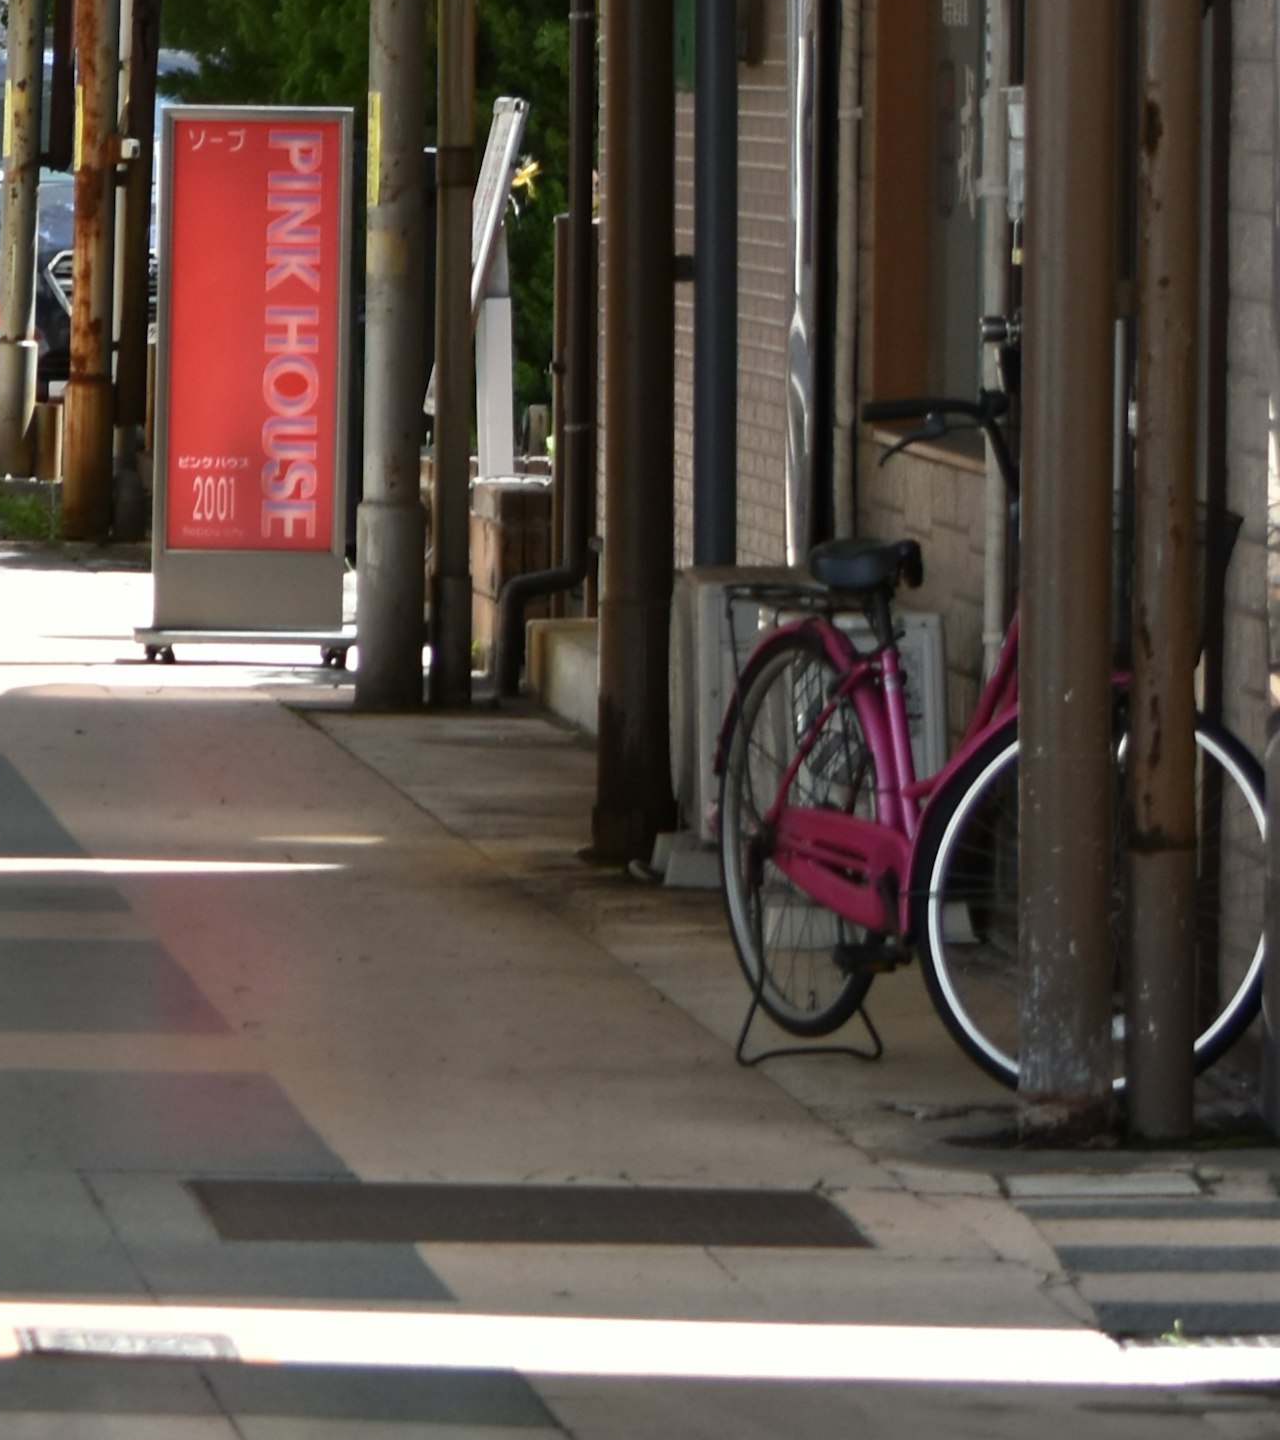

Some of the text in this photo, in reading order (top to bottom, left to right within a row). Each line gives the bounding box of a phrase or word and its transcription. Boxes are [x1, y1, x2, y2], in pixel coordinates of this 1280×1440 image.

[260, 129, 324, 540] PINK HOUSE
[192, 475, 236, 520] 2001
